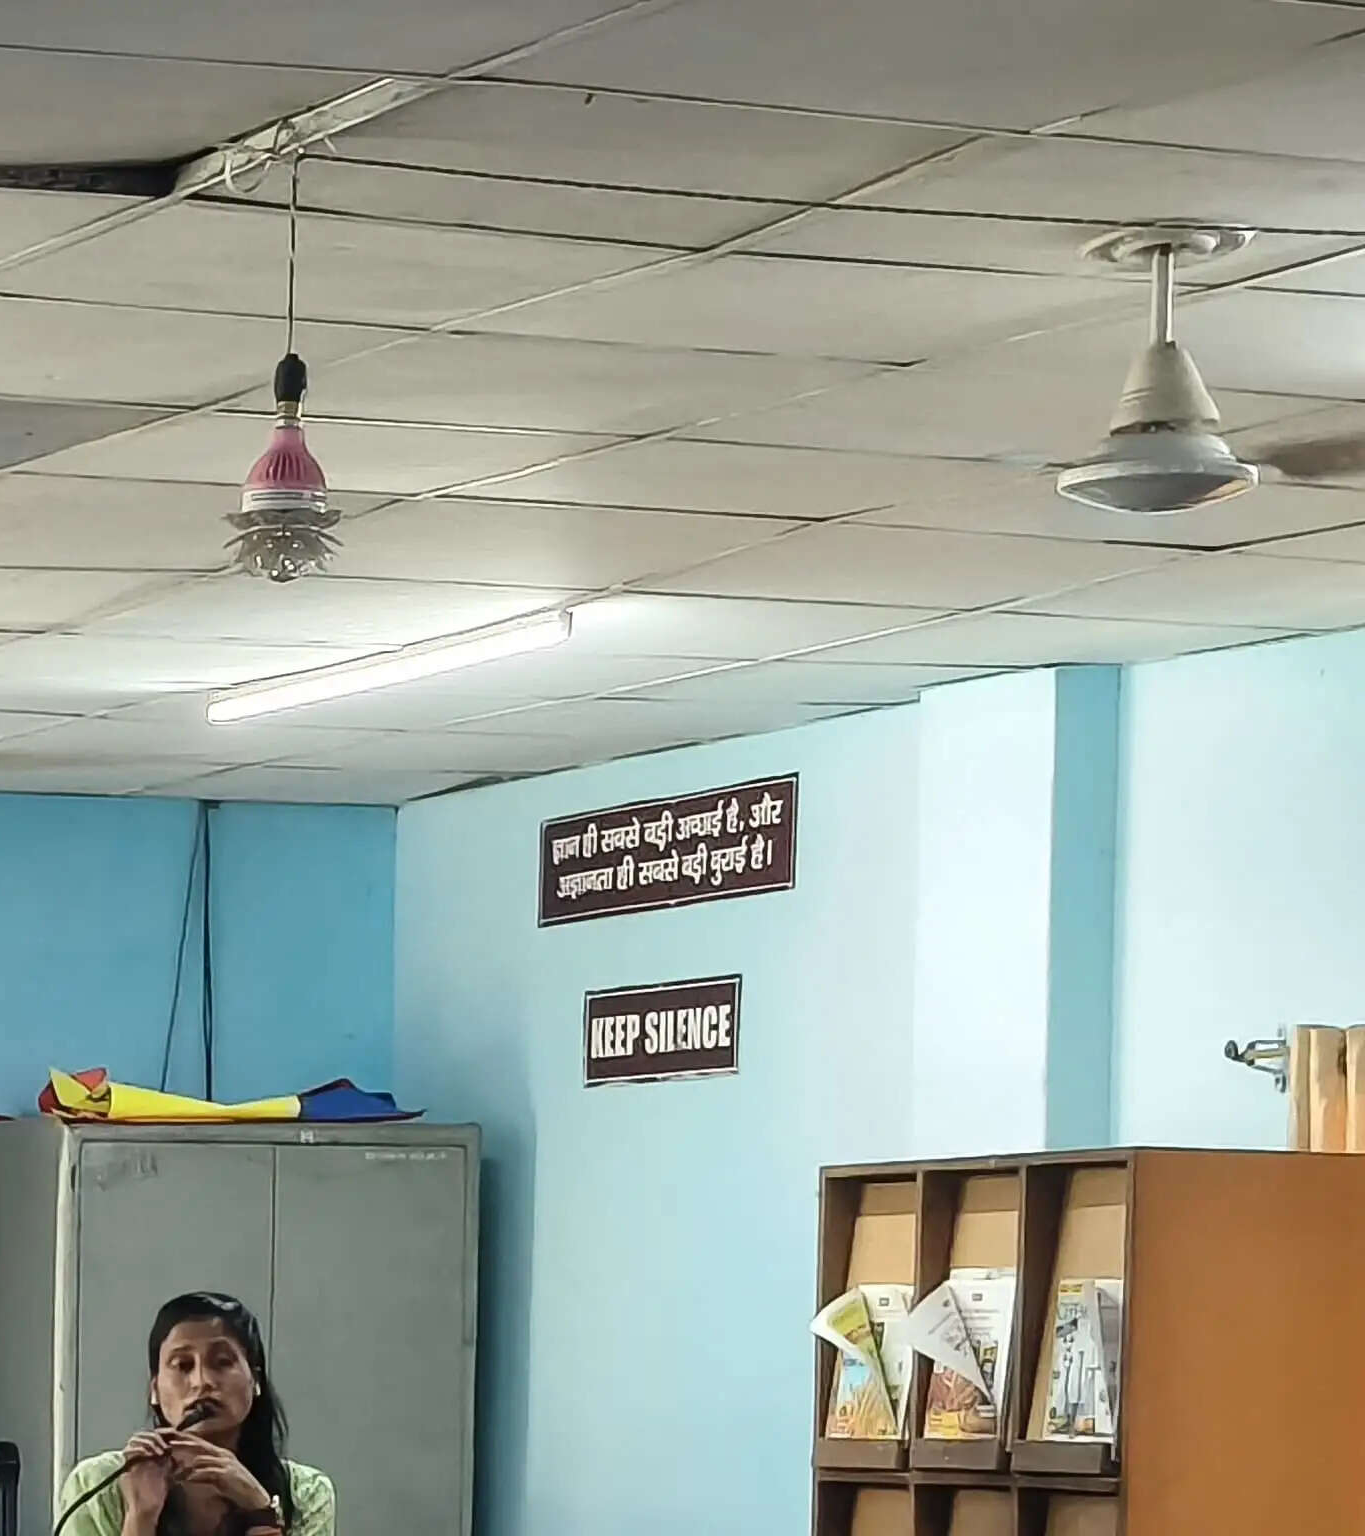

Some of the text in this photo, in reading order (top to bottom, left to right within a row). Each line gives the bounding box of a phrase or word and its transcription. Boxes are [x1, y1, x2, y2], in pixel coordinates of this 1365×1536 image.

[601, 816, 640, 853] सबसे
[643, 810, 673, 852] बड़ी
[748, 792, 784, 828] और
[557, 866, 614, 899] अज्ञानता
[617, 854, 634, 890] ही
[639, 848, 679, 885] सबसे
[681, 842, 708, 885] बड़ी
[710, 836, 747, 886] बुराई
[590, 1004, 732, 1059] KEEP SILENCE
